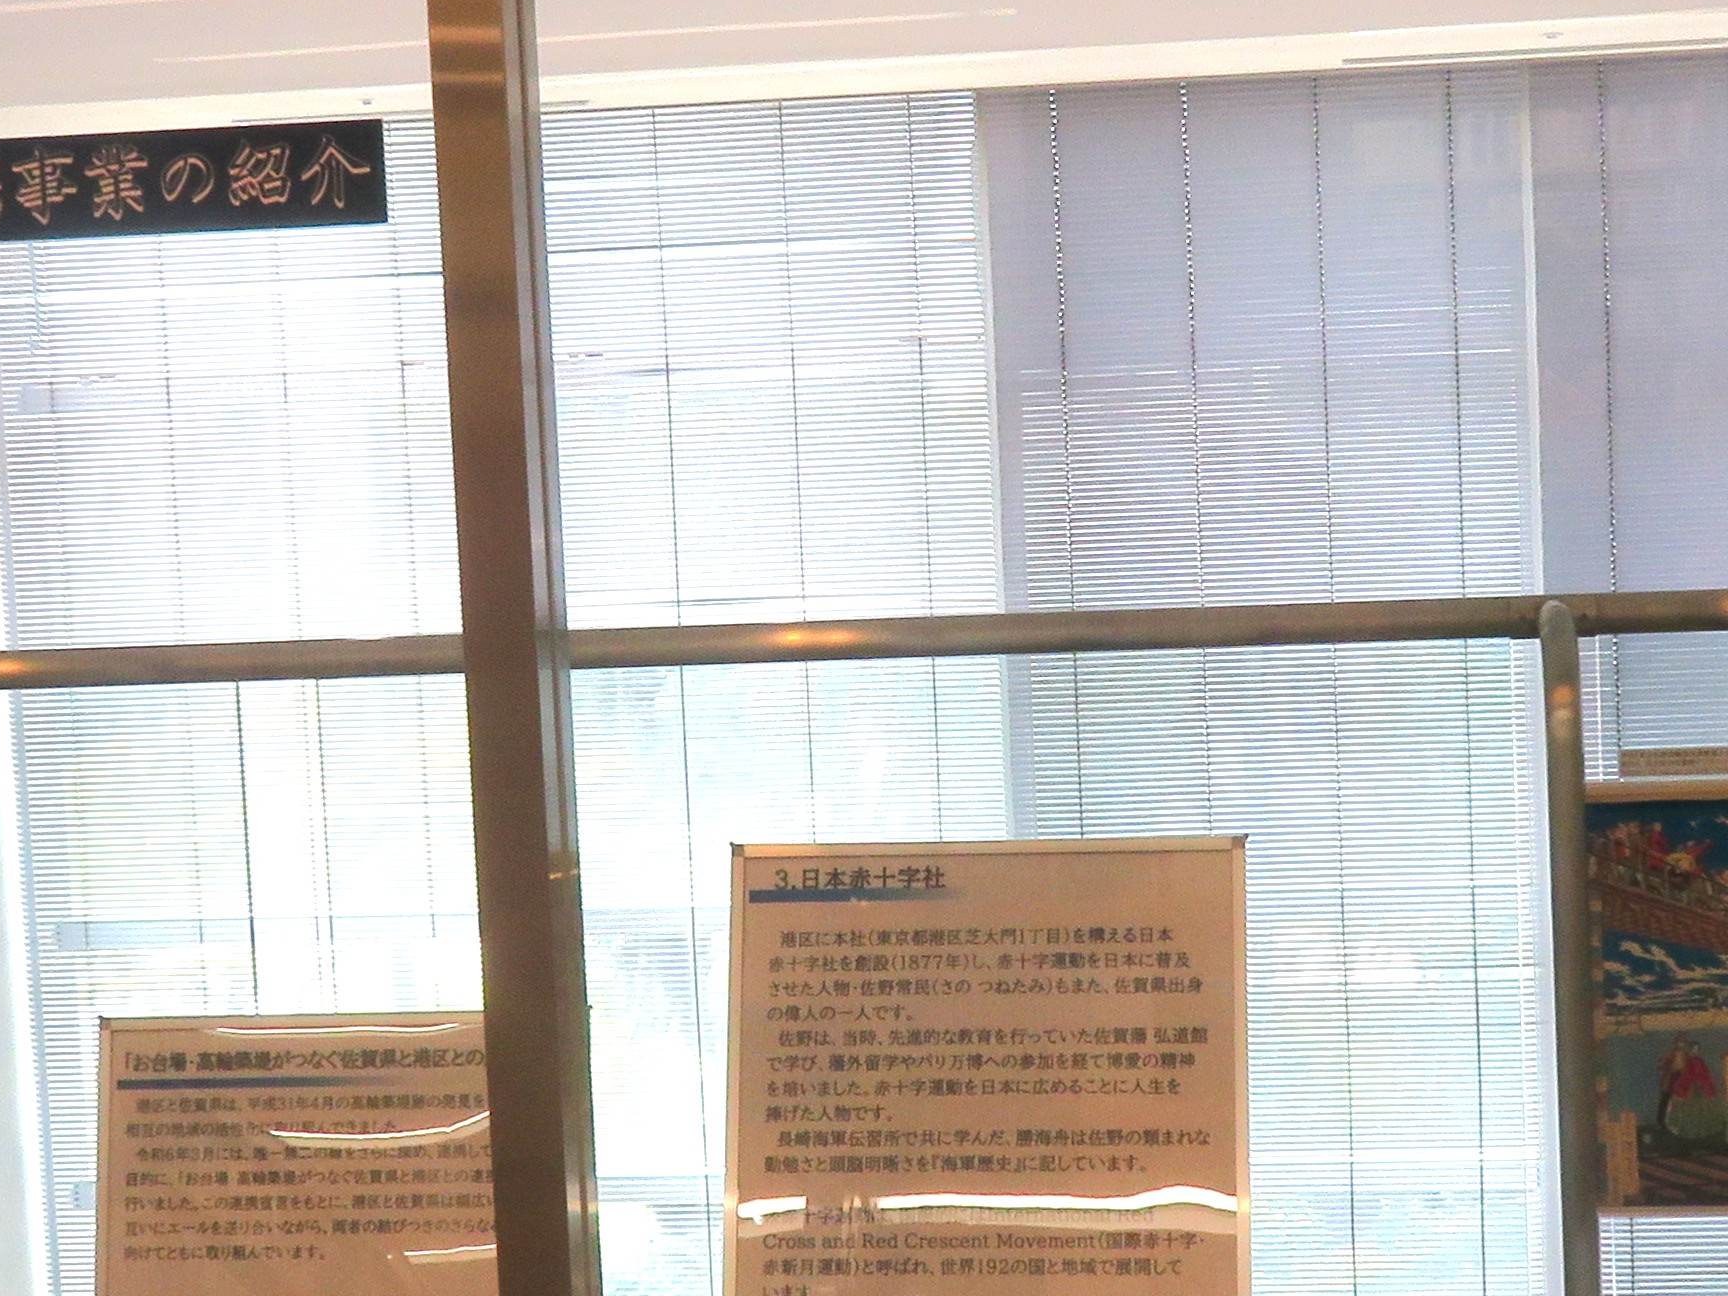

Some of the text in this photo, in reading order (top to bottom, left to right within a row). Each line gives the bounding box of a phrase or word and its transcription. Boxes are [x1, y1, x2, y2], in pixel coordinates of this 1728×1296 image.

[775, 865, 945, 891] 3.日本赤十字社
[767, 1003, 914, 1022] の偉人の一人です。
[763, 1233, 816, 1250] Cross
[862, 1232, 898, 1249] Red
[905, 1233, 990, 1249] Crescent
